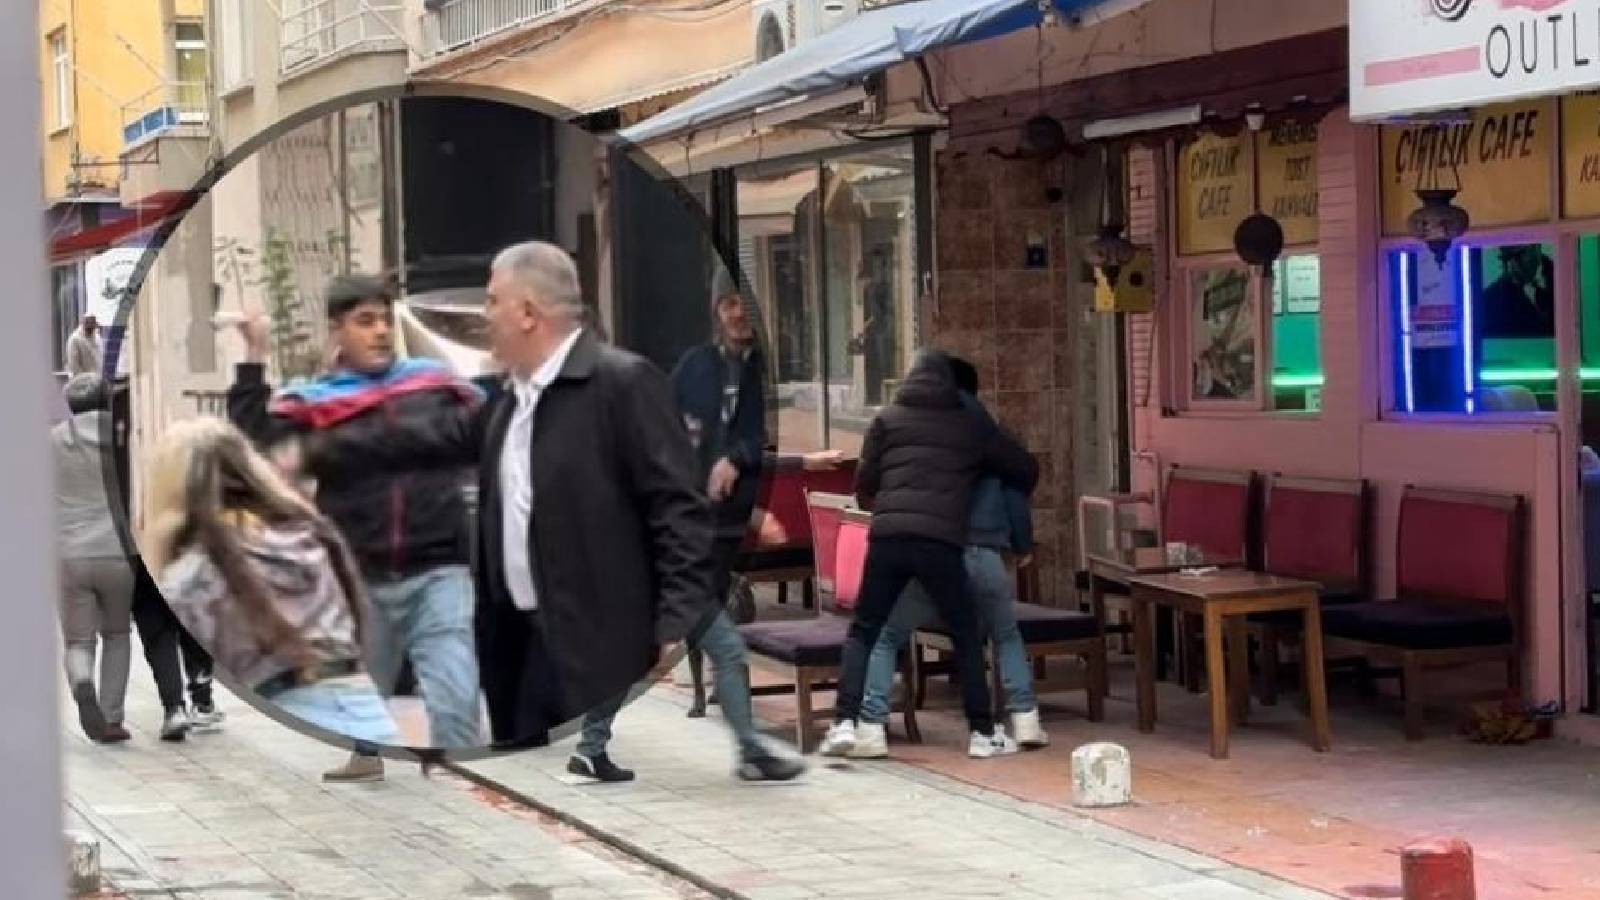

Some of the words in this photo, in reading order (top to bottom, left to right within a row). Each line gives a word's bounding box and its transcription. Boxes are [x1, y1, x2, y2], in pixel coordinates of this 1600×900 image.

[1486, 8, 1600, 79] OUTL
[1479, 109, 1539, 164] CAFE
[1199, 184, 1233, 220] CAFE
